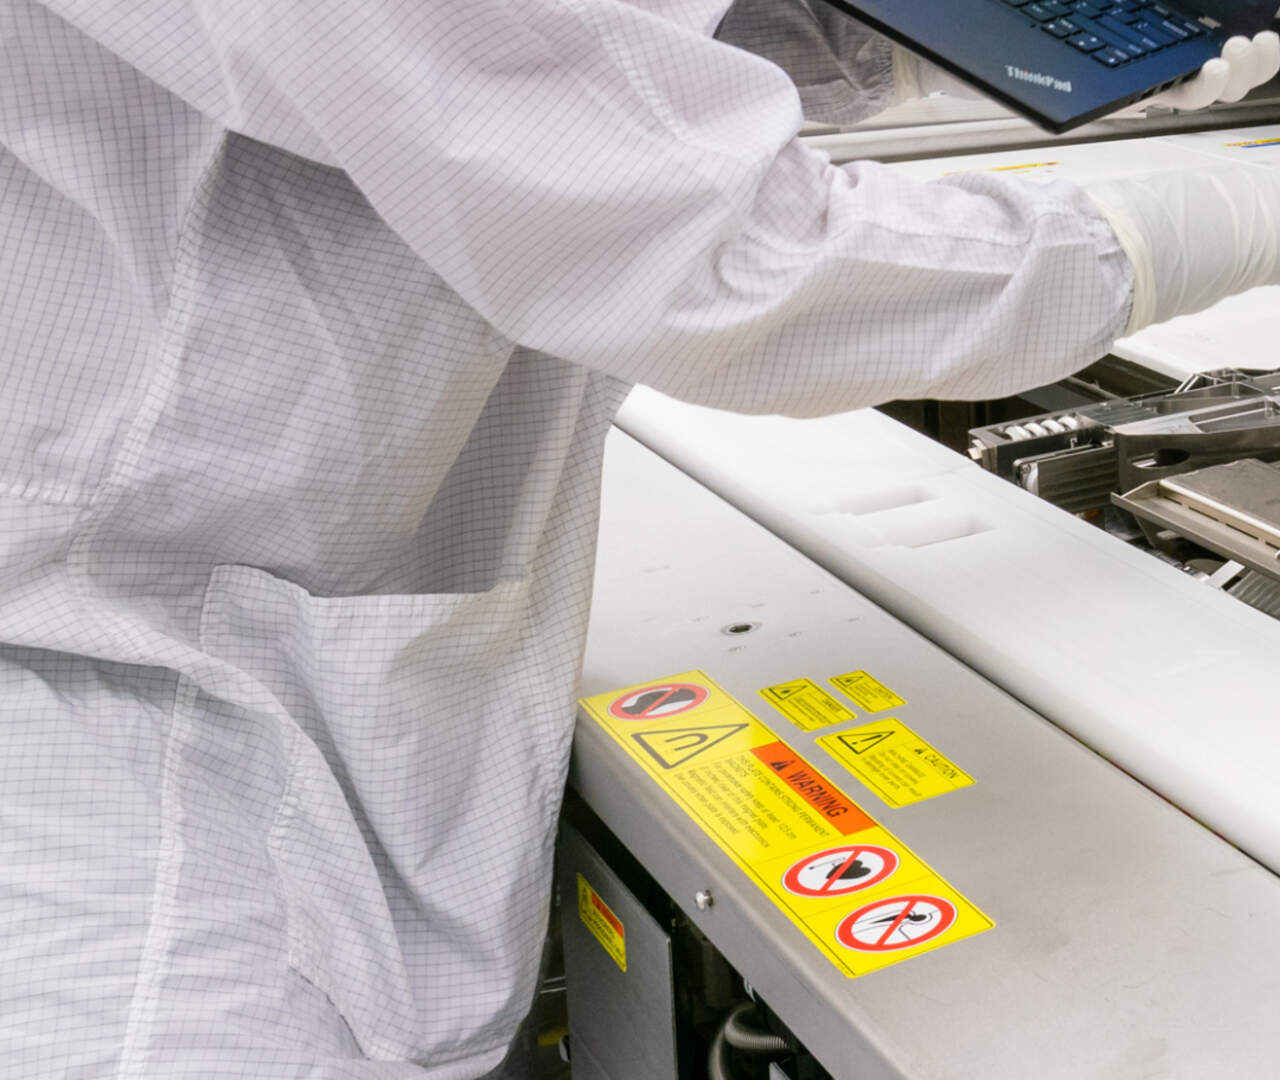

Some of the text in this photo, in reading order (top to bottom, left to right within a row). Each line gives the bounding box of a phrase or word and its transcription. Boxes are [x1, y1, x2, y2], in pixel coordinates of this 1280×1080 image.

[1005, 64, 1073, 94] ThinkPad
[924, 753, 960, 779] CAUTION
[787, 770, 848, 818] WARNING
